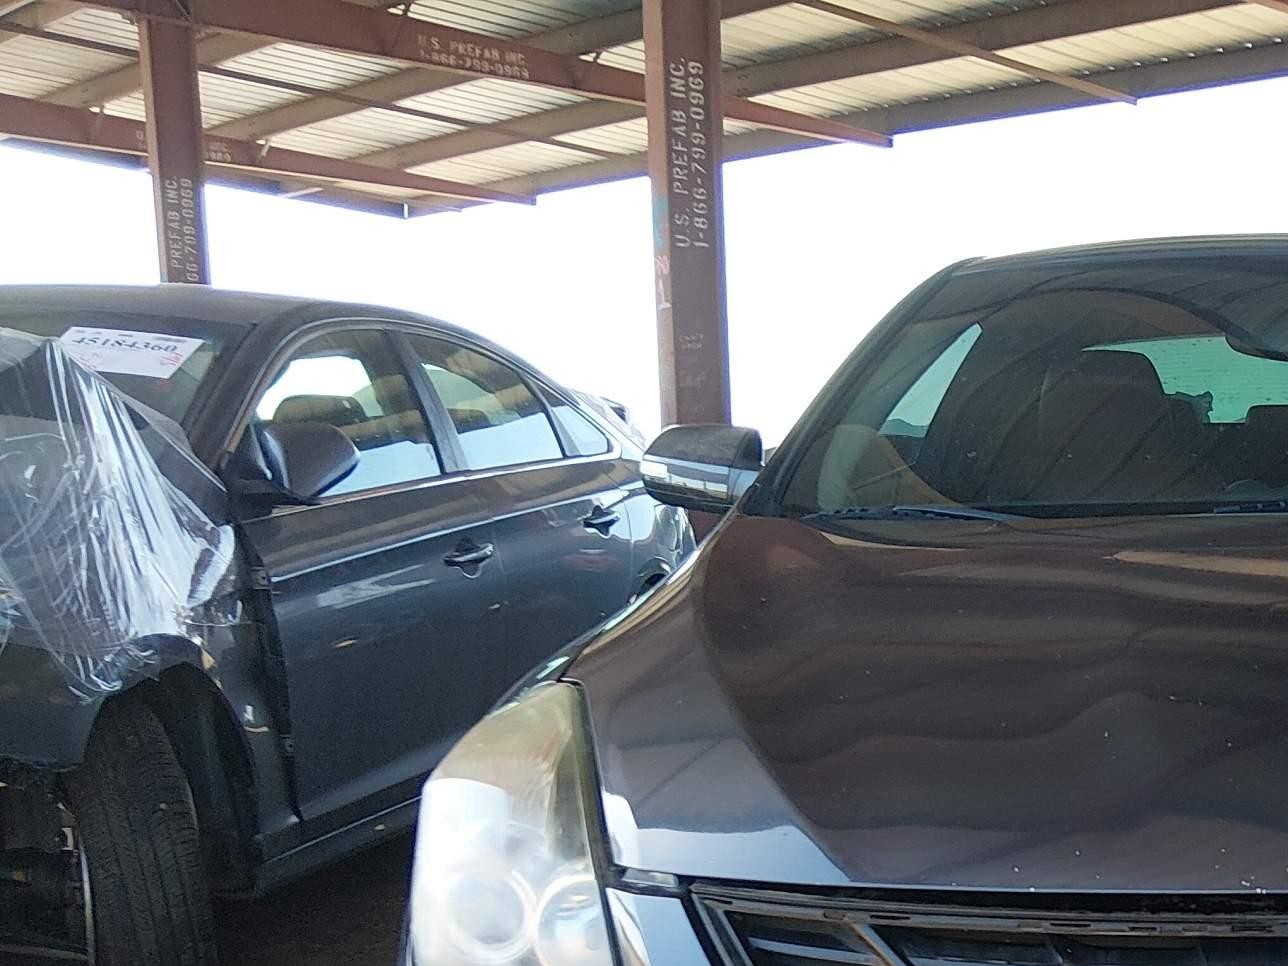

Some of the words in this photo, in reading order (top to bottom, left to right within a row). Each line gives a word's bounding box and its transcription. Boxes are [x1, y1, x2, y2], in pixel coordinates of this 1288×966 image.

[669, 57, 687, 99] INC.
[672, 110, 689, 195] PREFAB
[687, 60, 710, 249] 1-866-799-0969
[167, 210, 184, 269] PREFAB
[673, 206, 691, 248] U.S.
[71, 336, 179, 353] 45184360
